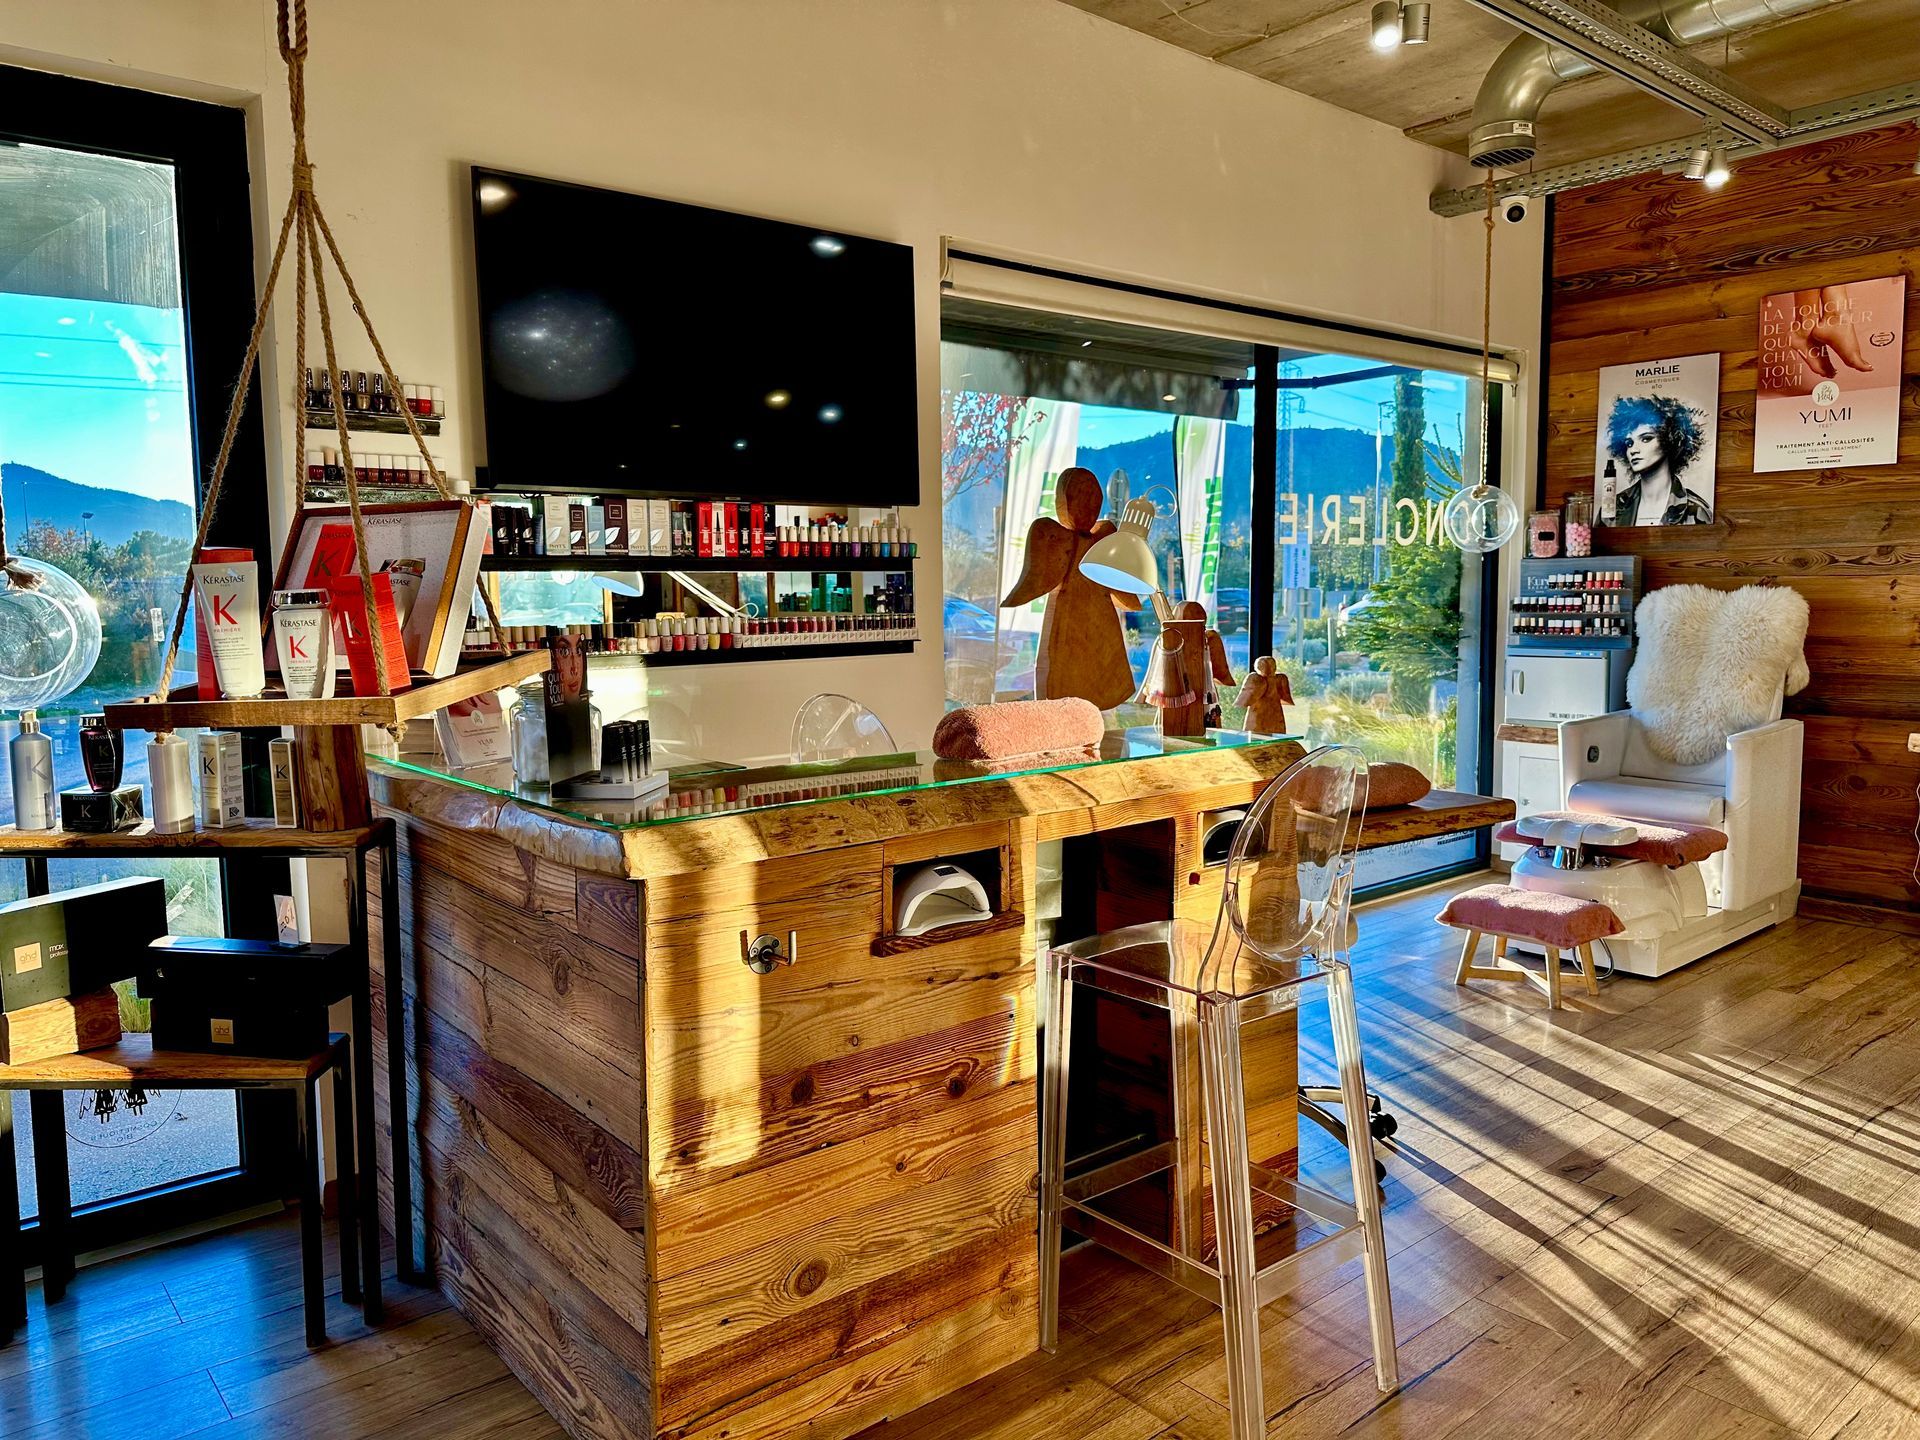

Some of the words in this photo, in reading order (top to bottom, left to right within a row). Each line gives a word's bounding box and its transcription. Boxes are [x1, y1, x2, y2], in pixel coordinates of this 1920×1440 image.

[1764, 309, 1784, 322] LA
[1792, 297, 1857, 320] TOUCHE
[1764, 323, 1784, 336] DE
[1790, 310, 1873, 333] DOUCEUR
[1763, 336, 1792, 351] QUI
[1763, 346, 1830, 364] CHANGE
[1635, 364, 1681, 378] MARLIE
[1763, 364, 1803, 378] TOUT
[1762, 375, 1802, 389] YUMI
[1799, 406, 1852, 424] YUMI
[1776, 441, 1815, 450] TRAITEMENT
[213, 593, 239, 626] K
[289, 635, 309, 659] K
[203, 756, 216, 776] K
[275, 764, 289, 780] K
